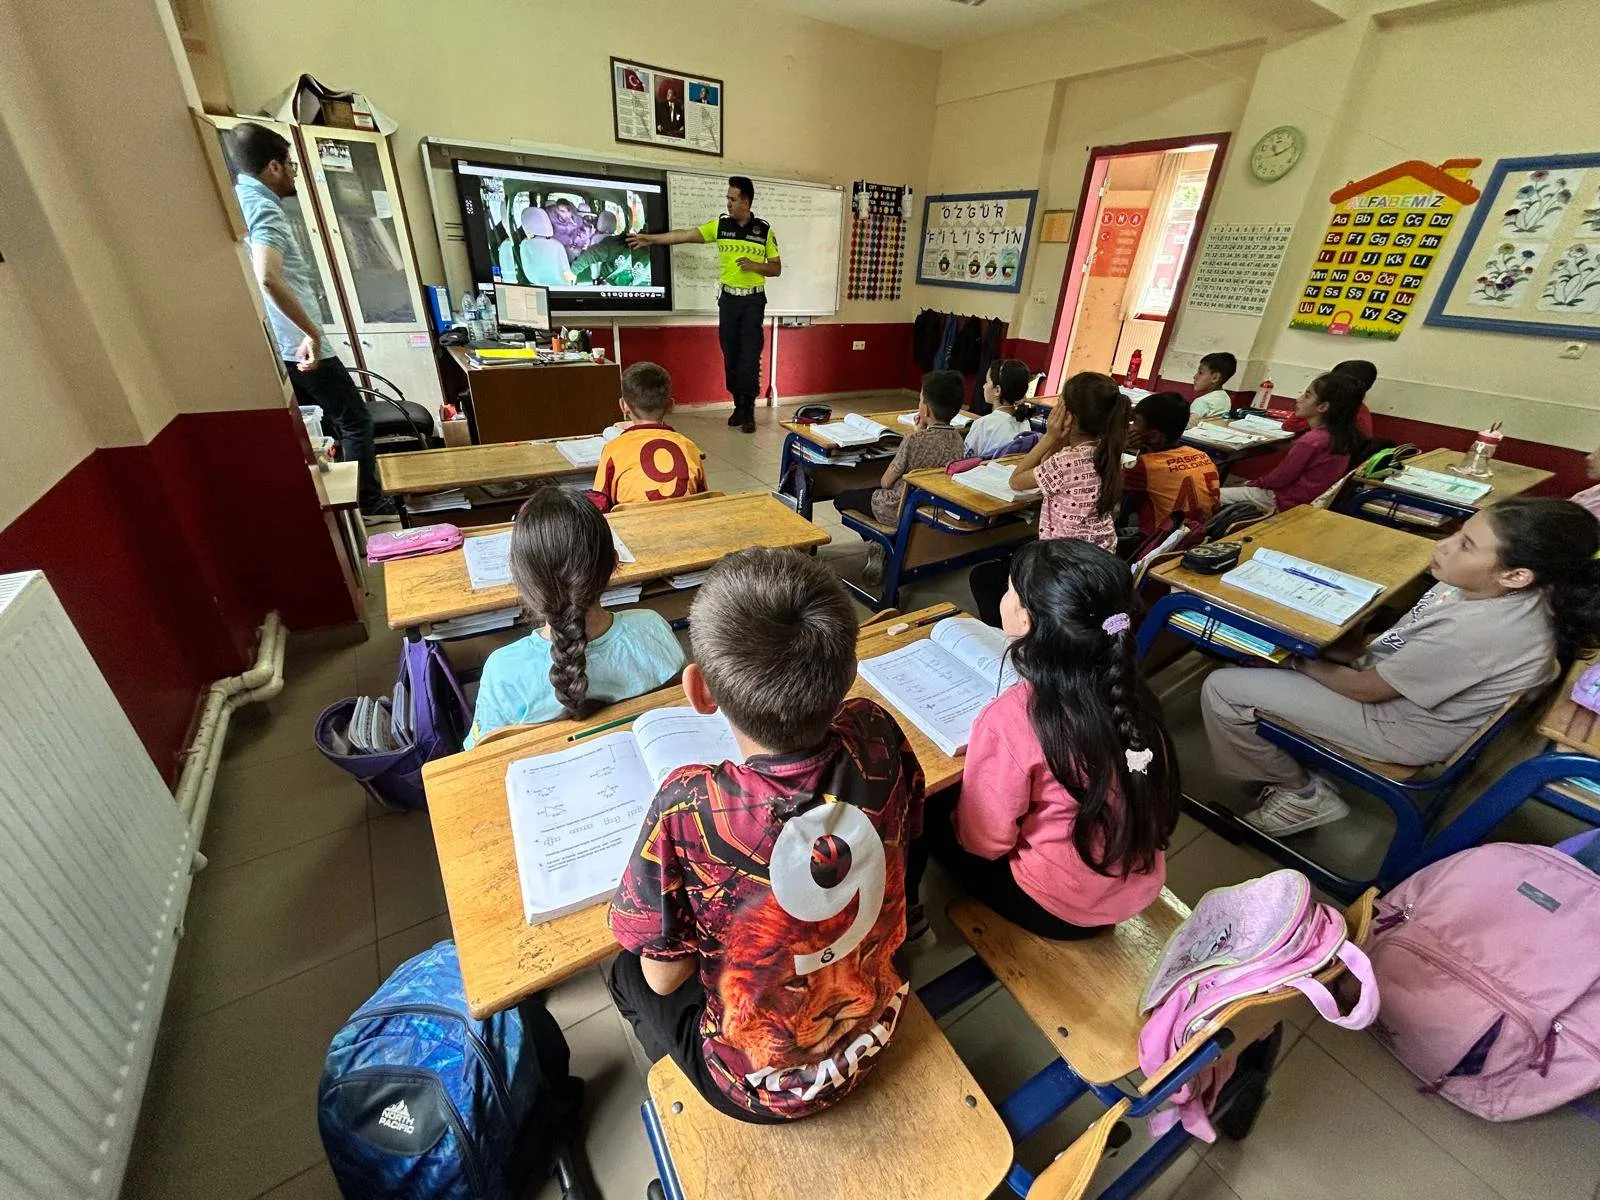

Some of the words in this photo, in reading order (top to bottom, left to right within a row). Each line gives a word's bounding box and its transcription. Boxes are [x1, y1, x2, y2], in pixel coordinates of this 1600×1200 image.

[1349, 195, 1445, 209] ALFABEMİZ
[943, 204, 1004, 219] ÖZGÜR
[1332, 215, 1347, 224] Aa
[1355, 214, 1370, 223] Bb
[1380, 215, 1396, 224] Cc
[1405, 215, 1423, 225] Çç
[1430, 215, 1450, 225] Dd
[928, 229, 1022, 245] FİLİSTİN
[1326, 233, 1340, 243] Ee
[1348, 234, 1363, 244] Ff
[1370, 234, 1387, 245] Gg
[1395, 234, 1412, 247] Ğğ
[1420, 236, 1438, 247] Hh
[1362, 253, 1378, 264] Jj
[1386, 254, 1403, 264] Kk
[1413, 256, 1426, 265] Ll
[1310, 271, 1327, 279] Mm
[1331, 271, 1347, 280] Nn
[1354, 272, 1370, 281] Oo
[1377, 272, 1394, 284] Öö
[1403, 276, 1420, 287] Pp
[1305, 287, 1318, 295] Rr
[1325, 287, 1339, 296] Ss
[1347, 287, 1362, 298] Şş
[1372, 291, 1385, 300] Tt
[1395, 293, 1412, 304] Uu
[1299, 302, 1313, 313] Üü
[1319, 305, 1333, 313] Vv
[1364, 308, 1379, 319] Yy
[1386, 311, 1403, 322] Zz
[640, 438, 690, 501] 9
[1073, 458, 1094, 467] STRON
[1073, 486, 1096, 494] STRONG
[769, 802, 887, 976] 9
[378, 1116, 415, 1135] PACIFIC
[381, 1109, 415, 1126] NORTH
